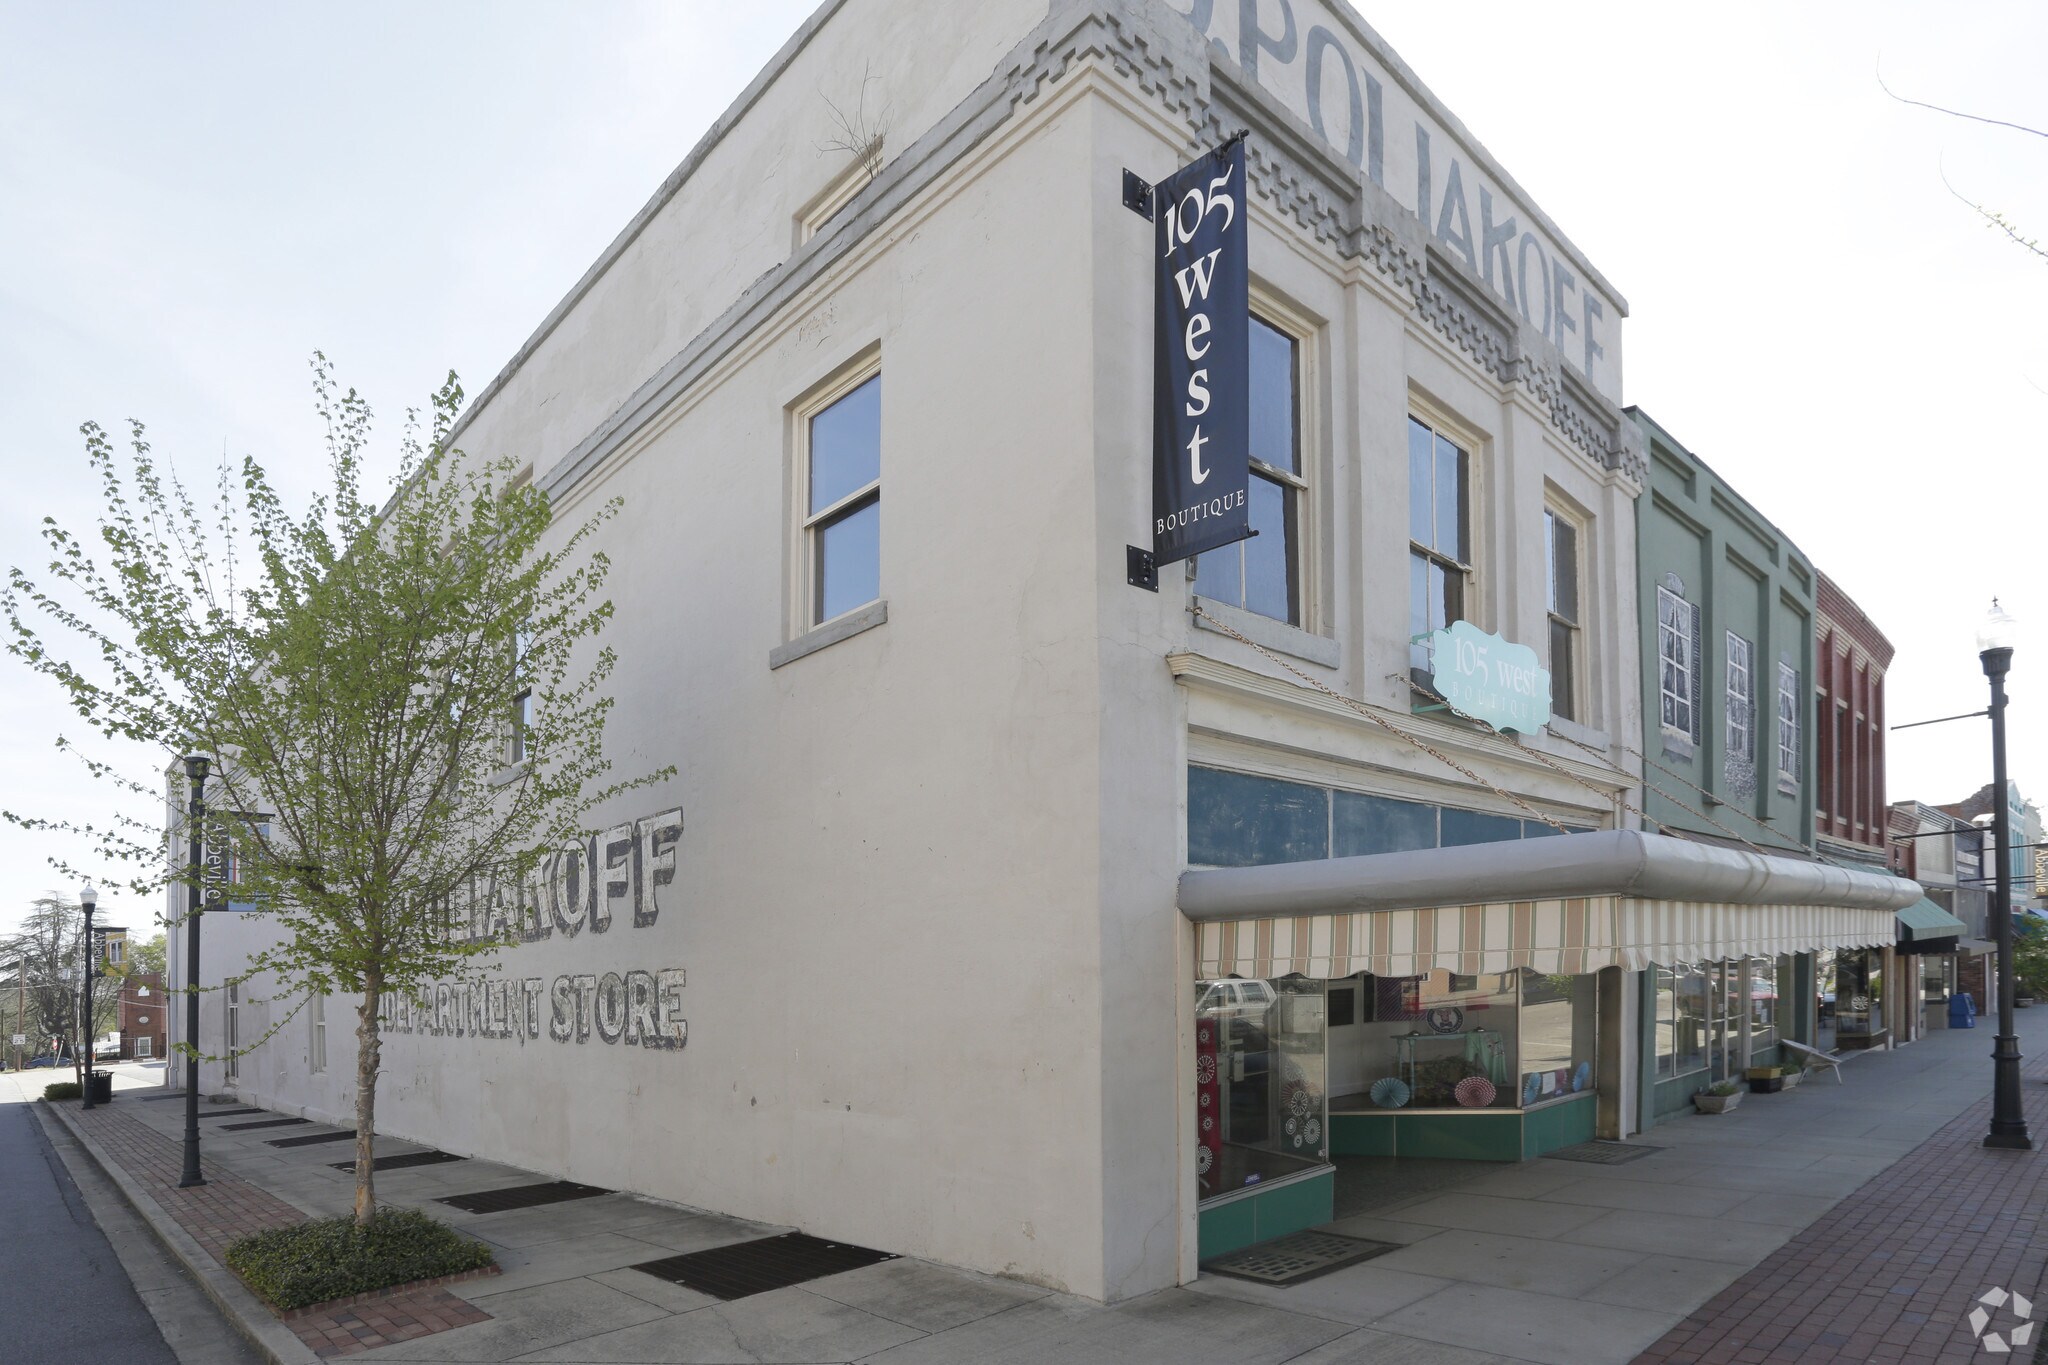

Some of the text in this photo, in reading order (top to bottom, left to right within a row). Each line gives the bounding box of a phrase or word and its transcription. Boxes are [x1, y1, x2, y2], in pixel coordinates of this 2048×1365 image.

[1164, 163, 1235, 257] 105
[1174, 247, 1222, 485] west
[1156, 488, 1245, 535] BOUTIQUE
[1454, 637, 1538, 698] 105 west
[1453, 681, 1538, 721] BOUTIQUE
[2035, 849, 2048, 893] Abbeville
[380, 968, 688, 1052] DEPARTMENT STORE
